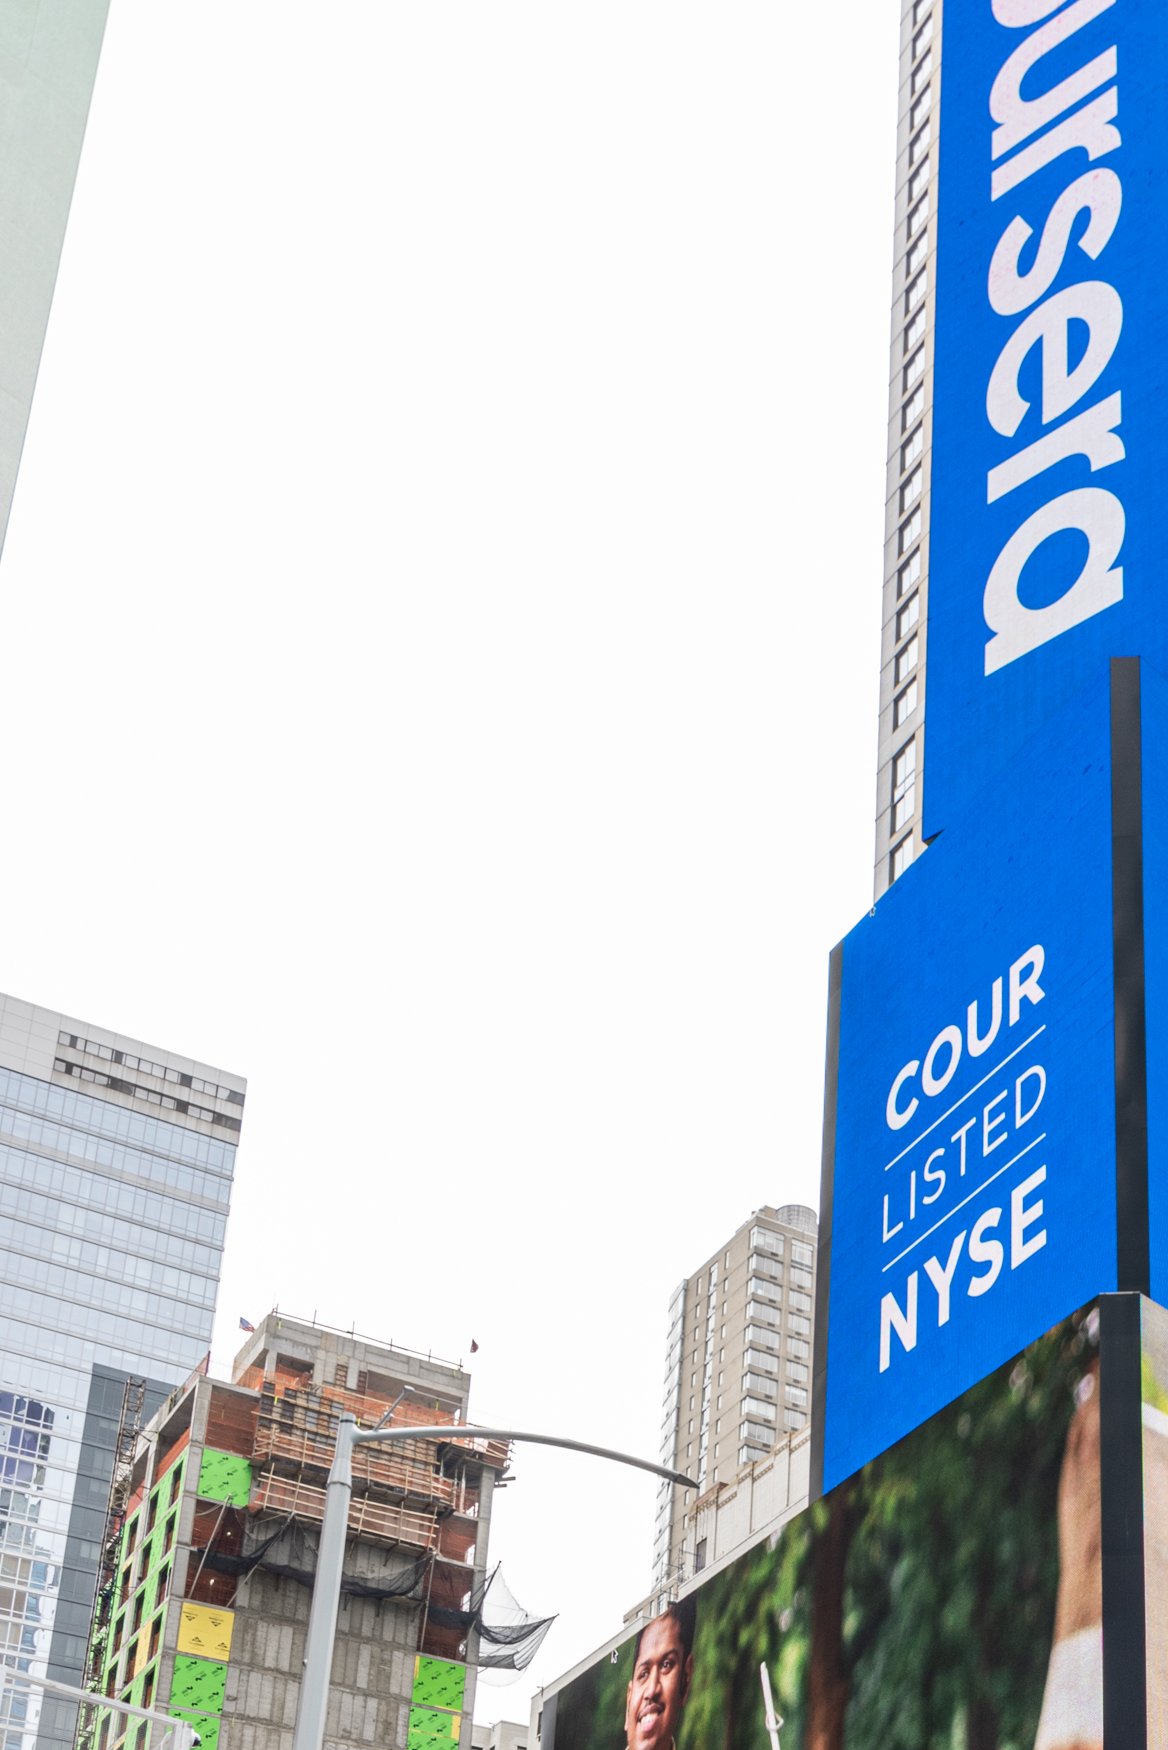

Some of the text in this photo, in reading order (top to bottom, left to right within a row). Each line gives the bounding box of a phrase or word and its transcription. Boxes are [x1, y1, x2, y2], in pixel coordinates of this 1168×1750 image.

[886, 943, 1047, 1131] COUR
[882, 1063, 1047, 1243] LISTED
[878, 1163, 1048, 1374] NYSE
